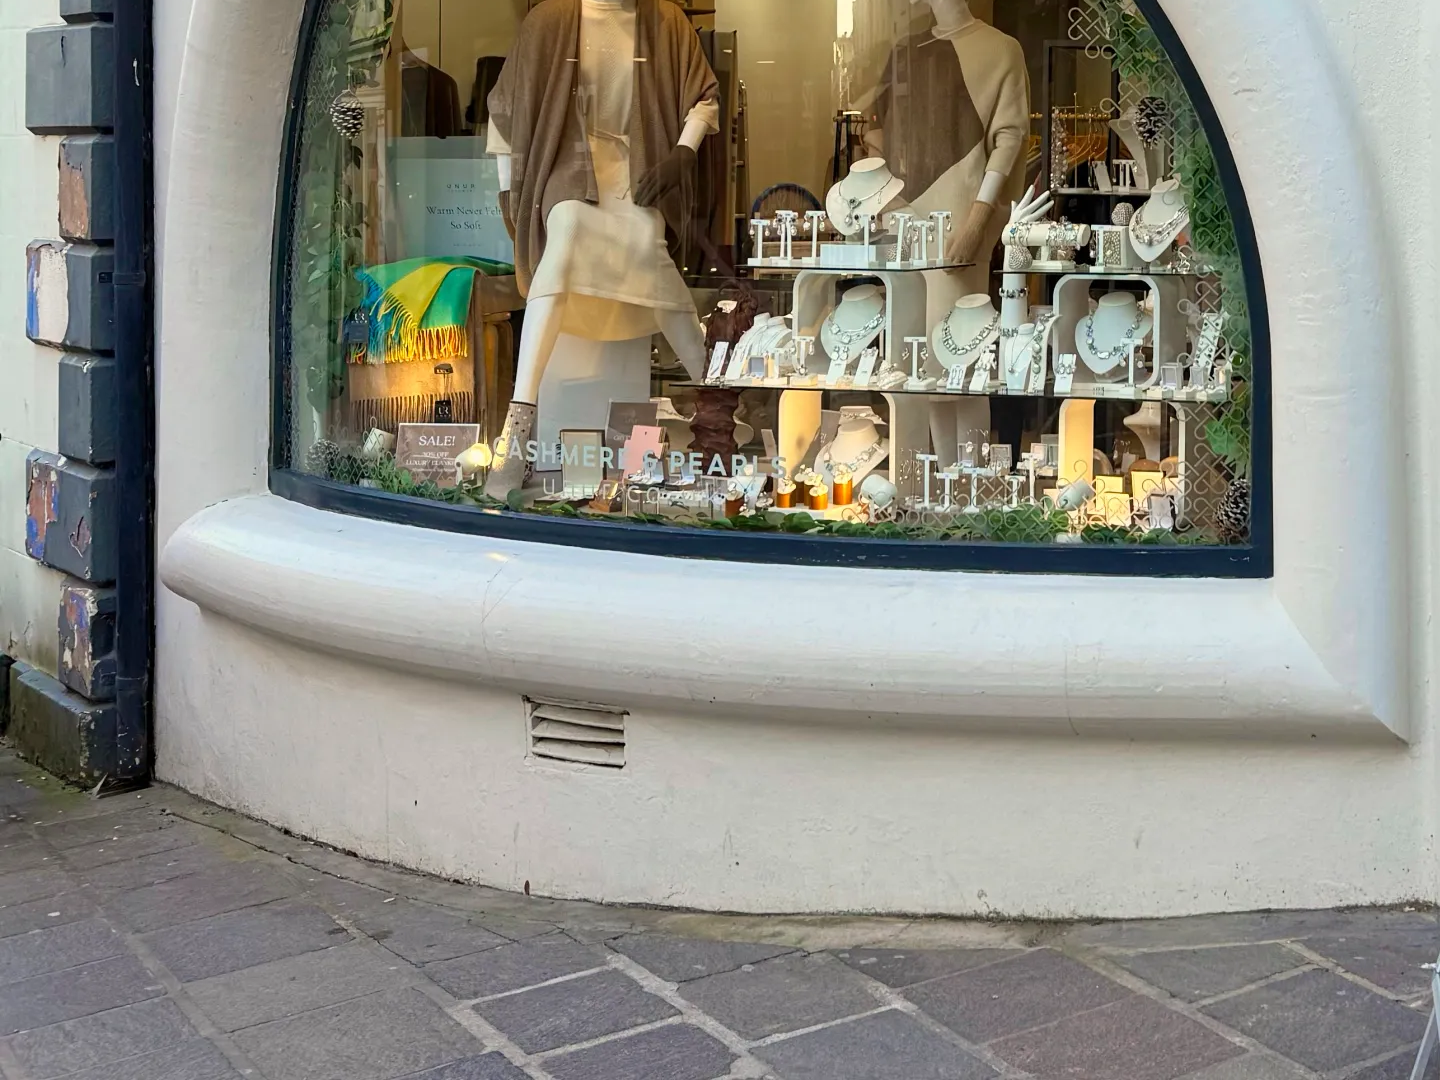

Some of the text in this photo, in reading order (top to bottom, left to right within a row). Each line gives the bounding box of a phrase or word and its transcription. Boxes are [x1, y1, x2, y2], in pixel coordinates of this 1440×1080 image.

[426, 206, 455, 215] Warm
[456, 206, 482, 215] Never
[450, 221, 482, 230] So Soft
[418, 435, 456, 446] SALE!
[493, 436, 629, 470] CASHMERE
[669, 451, 787, 478] PEARLS
